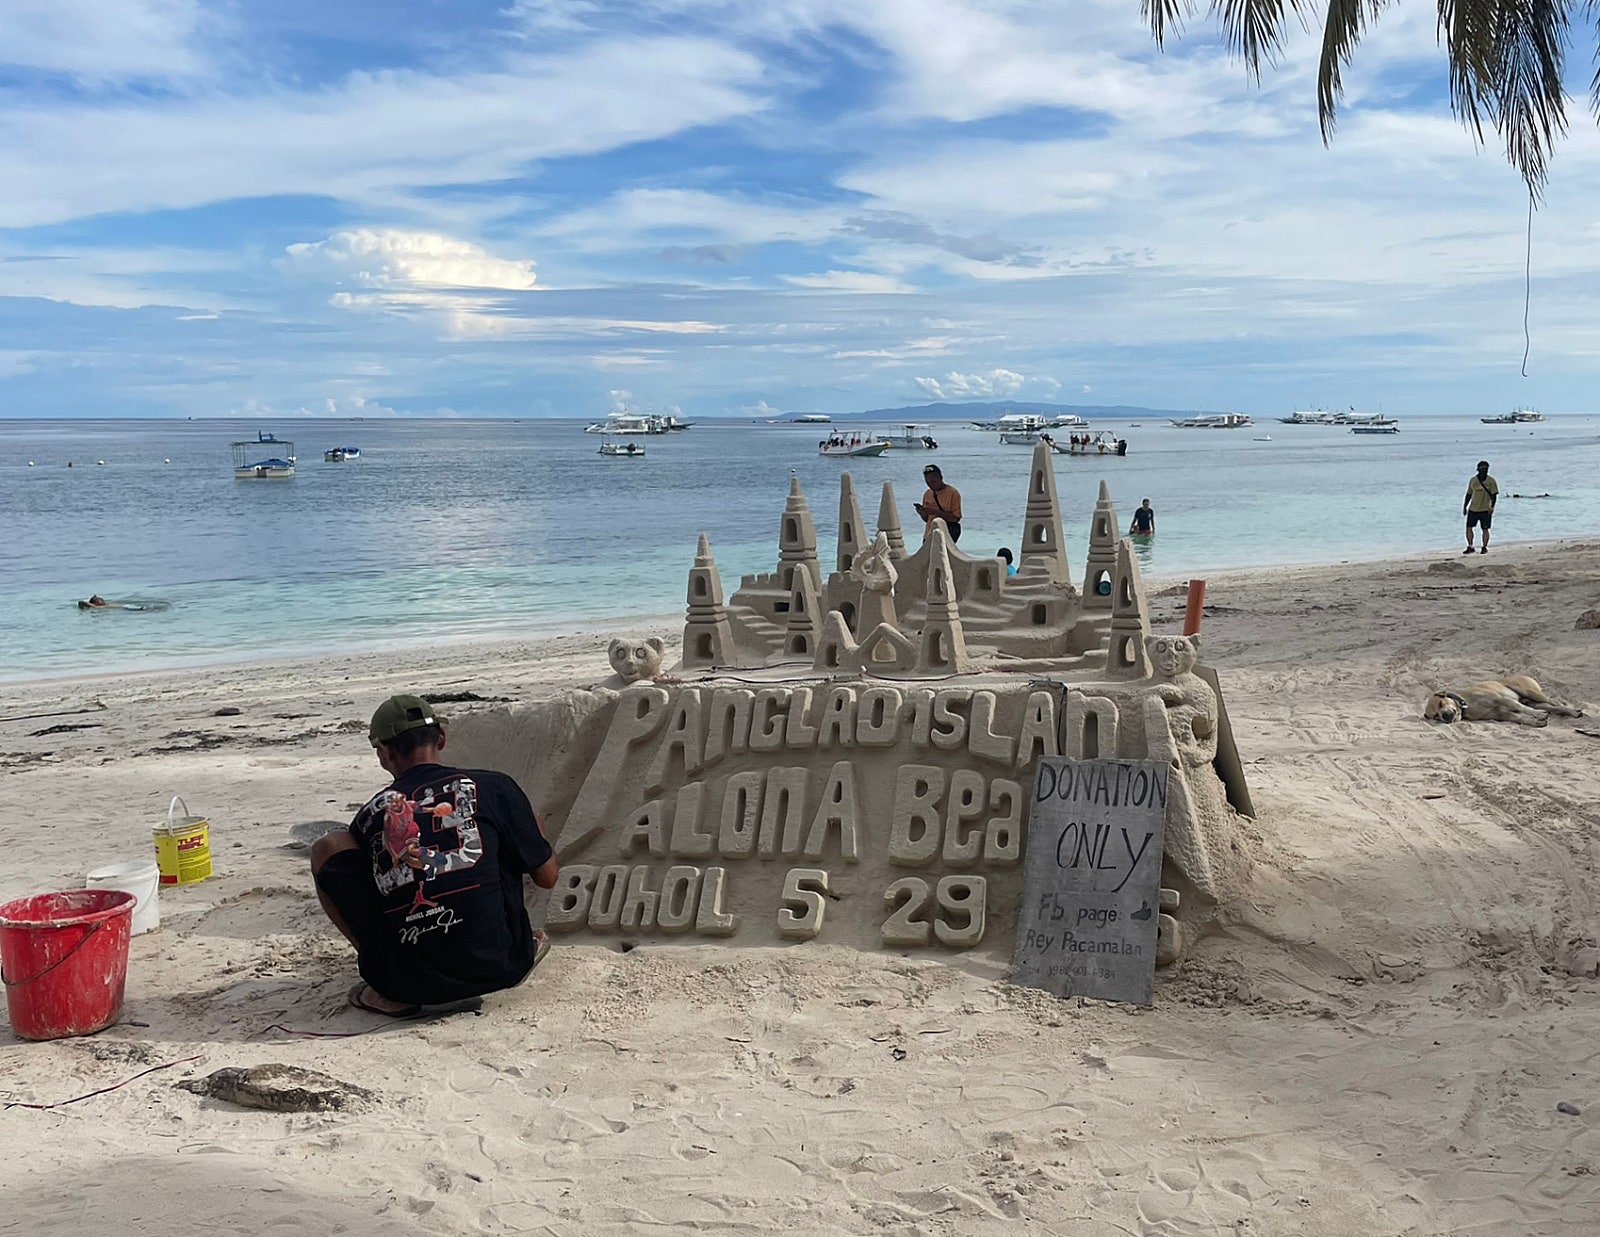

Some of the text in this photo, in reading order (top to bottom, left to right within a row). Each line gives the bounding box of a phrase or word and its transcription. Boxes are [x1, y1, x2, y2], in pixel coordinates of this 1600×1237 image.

[1036, 762, 1167, 808] DONATION
[1057, 822, 1154, 892] ONLY
[778, 868, 829, 940] 5
[881, 875, 987, 947] 29
[1038, 893, 1065, 920] Fb
[1024, 929, 1142, 955] Rey Pacamalan
